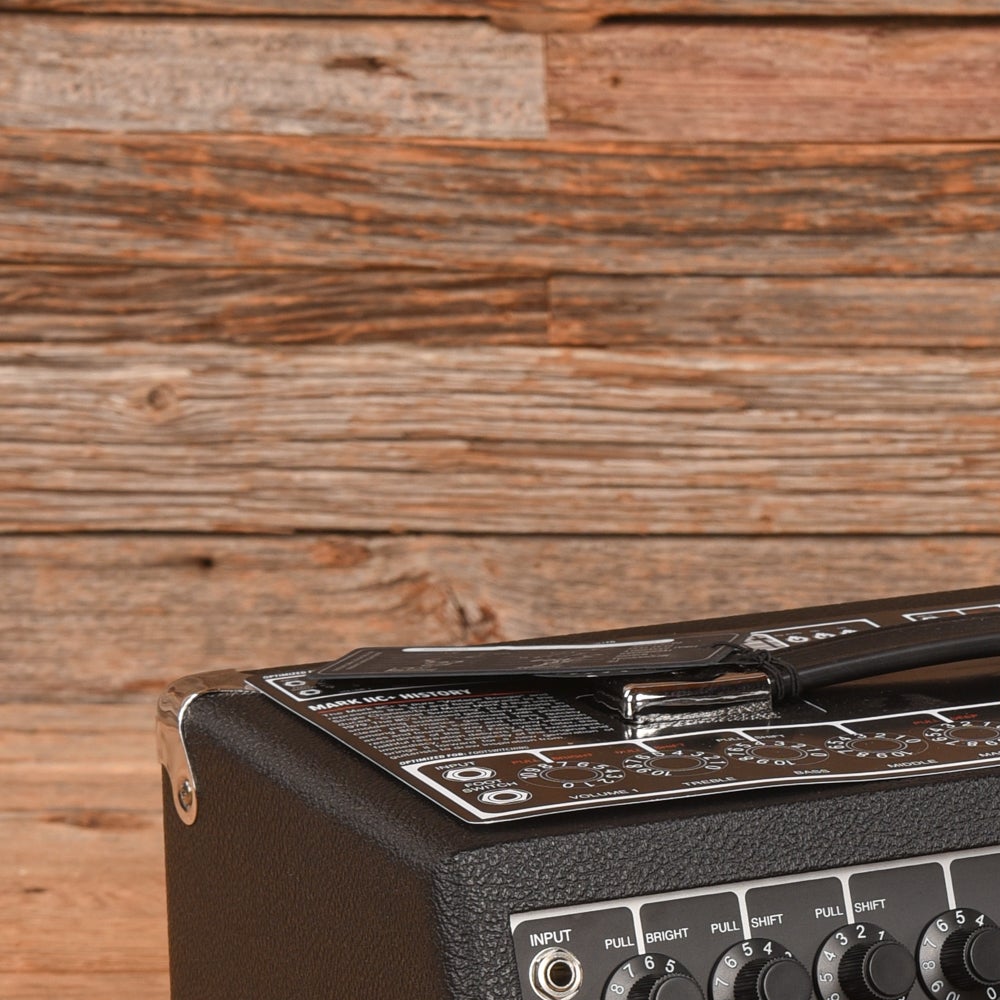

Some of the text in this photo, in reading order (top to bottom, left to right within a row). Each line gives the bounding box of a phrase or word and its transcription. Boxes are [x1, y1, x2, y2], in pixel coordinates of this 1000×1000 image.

[308, 698, 363, 712] MARK
[399, 688, 472, 700] HISTORY
[399, 753, 446, 766] OPTIMIZED
[468, 745, 530, 756] FOOTSWITCHING
[435, 761, 476, 771] INPUT
[462, 781, 519, 793] SWITCH
[569, 789, 630, 800] VOLUME
[815, 899, 886, 919] PULL SHIFT
[711, 914, 783, 935] PULL SHIFT
[956, 911, 966, 924] 5
[975, 914, 985, 926] 4
[856, 925, 866, 938] 2
[936, 919, 949, 932] 6
[530, 929, 572, 947] INPUT
[605, 927, 688, 950] PULL BRIGHT
[836, 933, 848, 945] 3
[742, 943, 753, 956] 5
[763, 941, 773, 955] 4
[725, 955, 739, 969] 6
[824, 950, 836, 961] 4
[644, 956, 655, 970] 6
[665, 959, 675, 973] 5
[623, 963, 636, 978] 7
